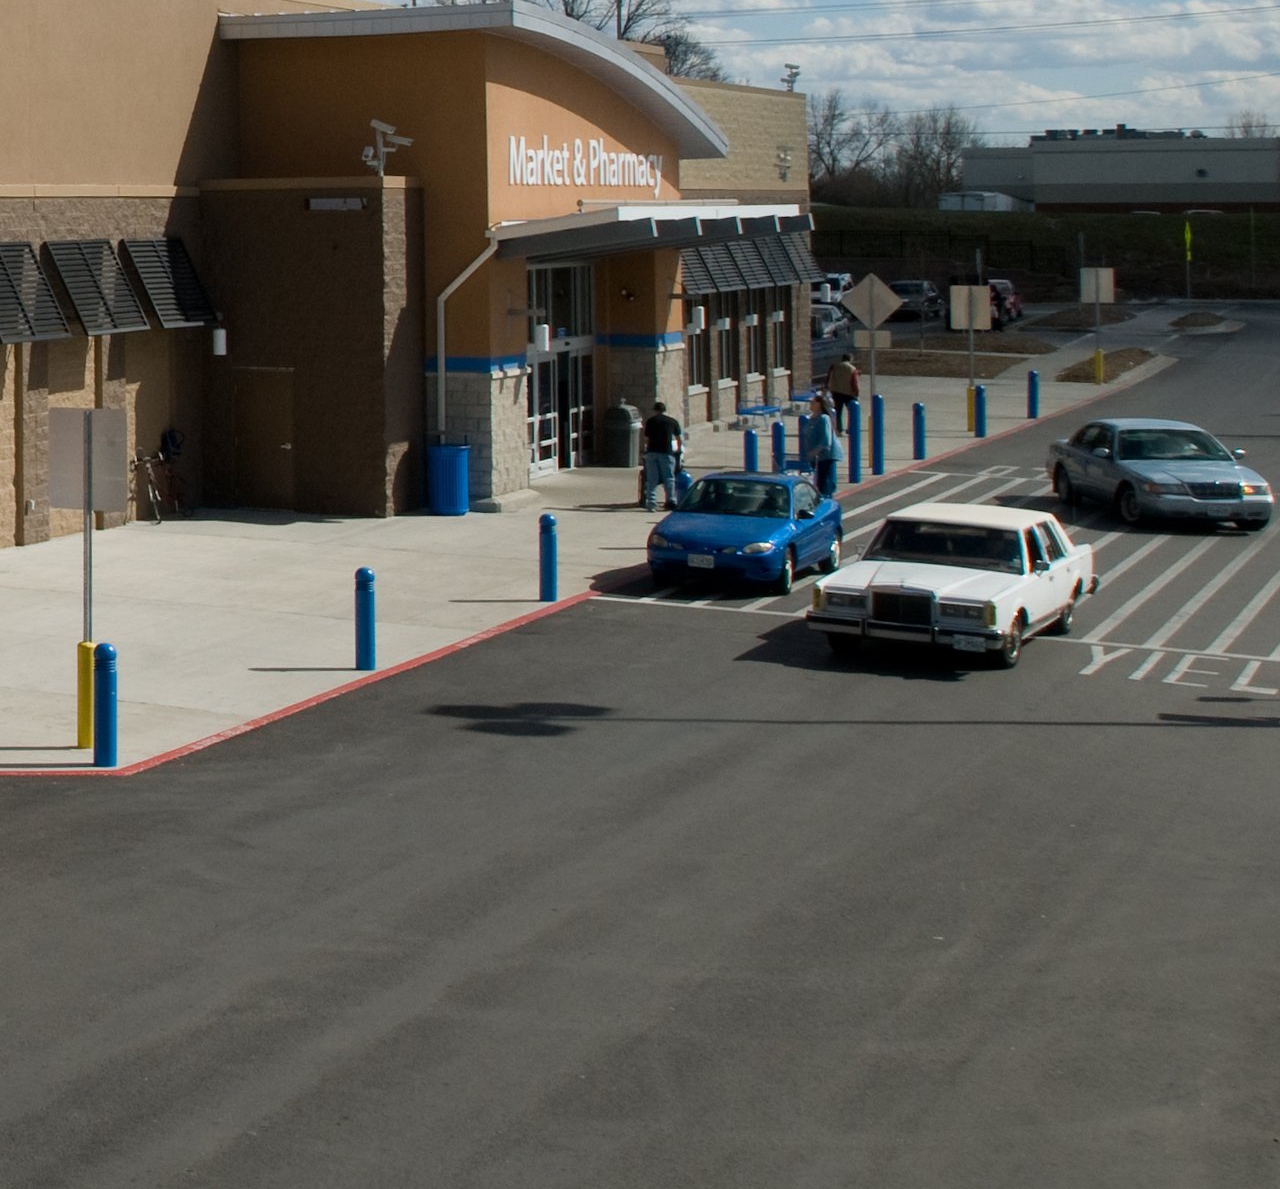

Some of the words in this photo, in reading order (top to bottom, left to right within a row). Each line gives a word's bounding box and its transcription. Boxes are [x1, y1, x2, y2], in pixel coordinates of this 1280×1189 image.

[509, 135, 570, 186] Market
[573, 138, 586, 186] &
[589, 137, 663, 199] Pharmacy
